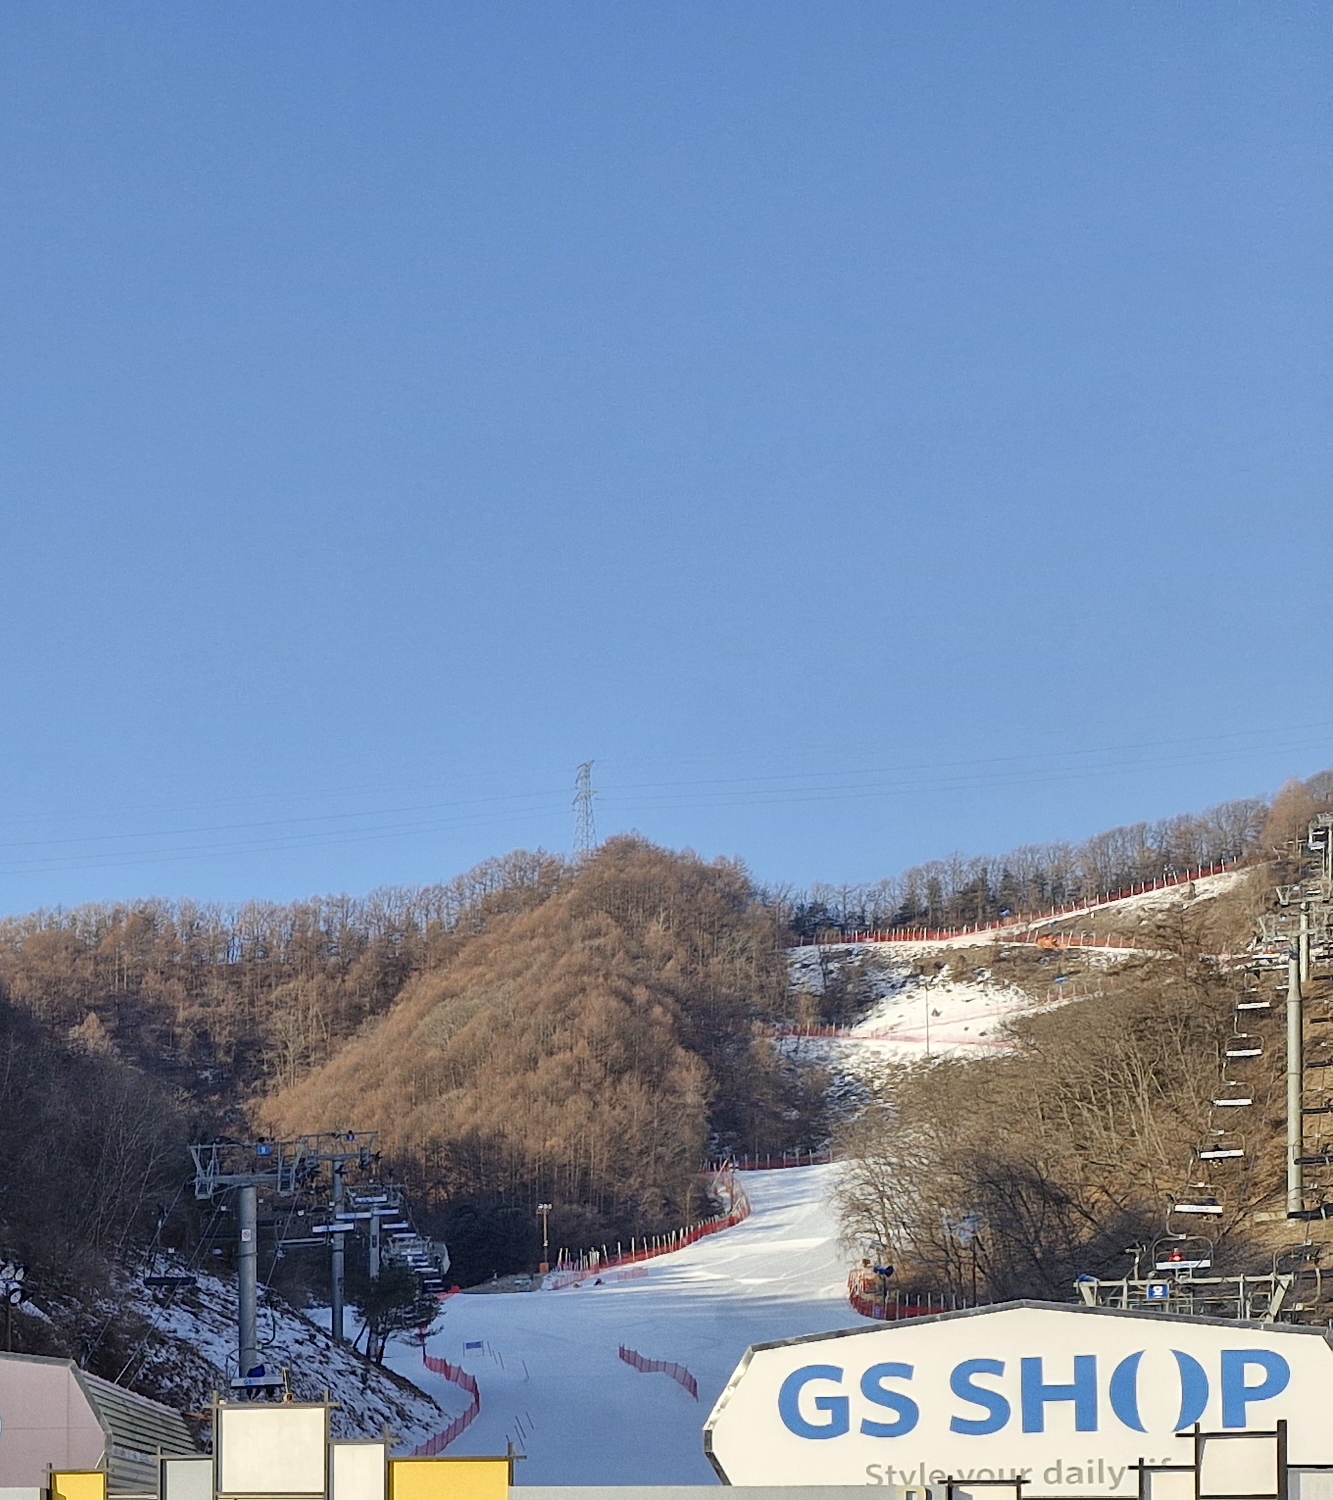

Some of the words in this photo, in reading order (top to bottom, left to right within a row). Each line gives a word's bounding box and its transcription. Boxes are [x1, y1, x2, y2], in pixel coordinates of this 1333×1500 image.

[778, 1362, 920, 1440] GS
[950, 1348, 1291, 1436] SHOP
[1043, 1458, 1127, 1491] daily
